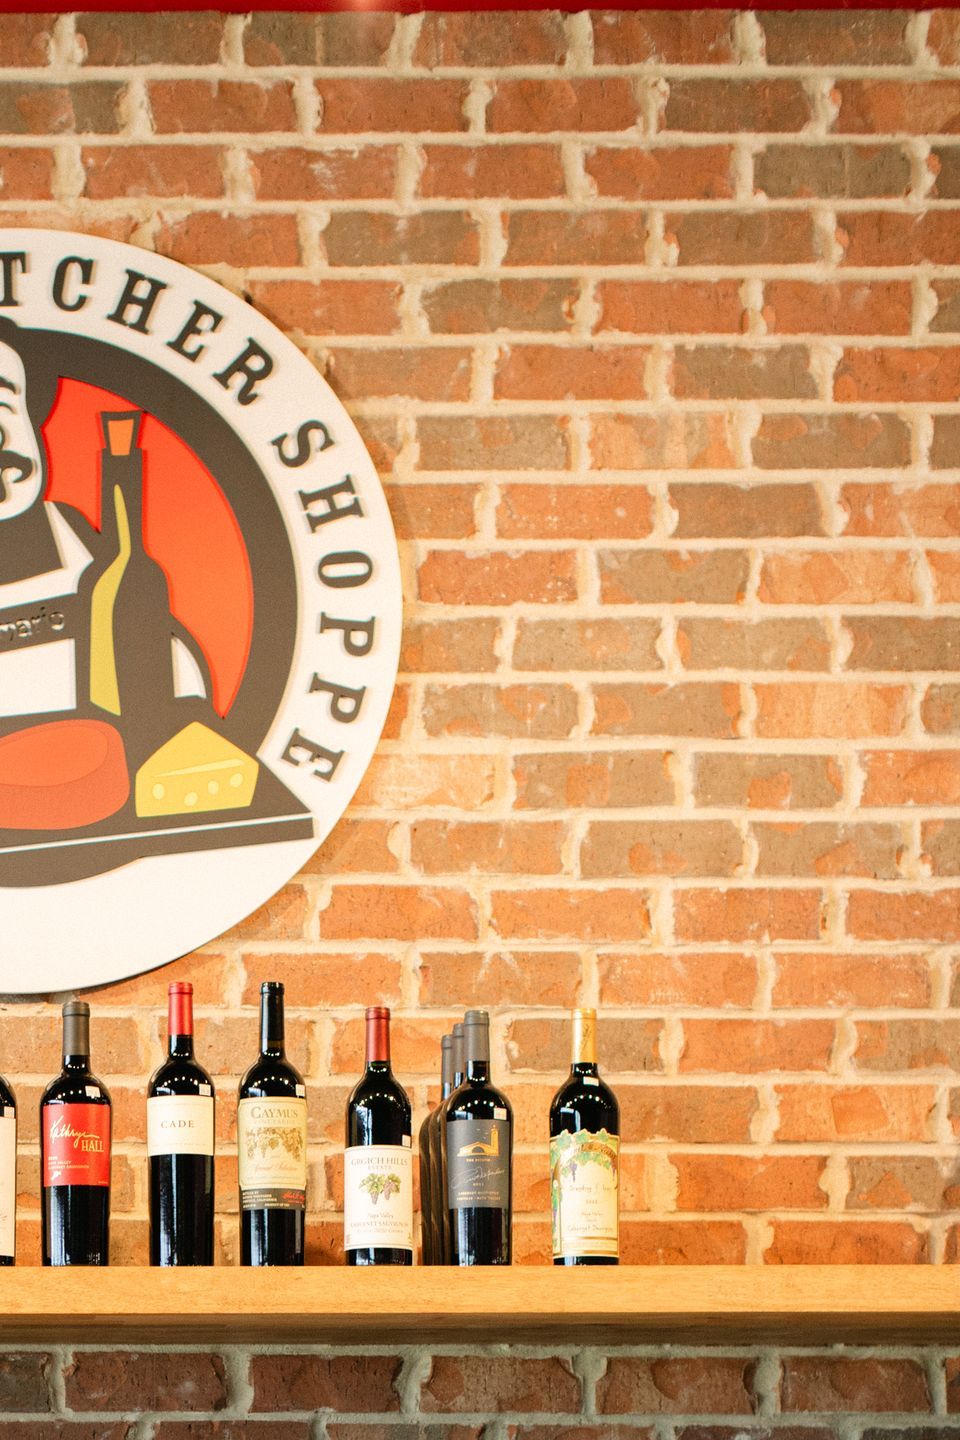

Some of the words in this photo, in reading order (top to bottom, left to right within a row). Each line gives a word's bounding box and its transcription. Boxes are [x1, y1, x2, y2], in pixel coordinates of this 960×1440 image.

[269, 418, 379, 784] SHOPPE
[250, 1106, 298, 1119] CAYMUS
[160, 1120, 195, 1129] CADE
[49, 1115, 100, 1149] Kathryn
[81, 1140, 105, 1152] HALL
